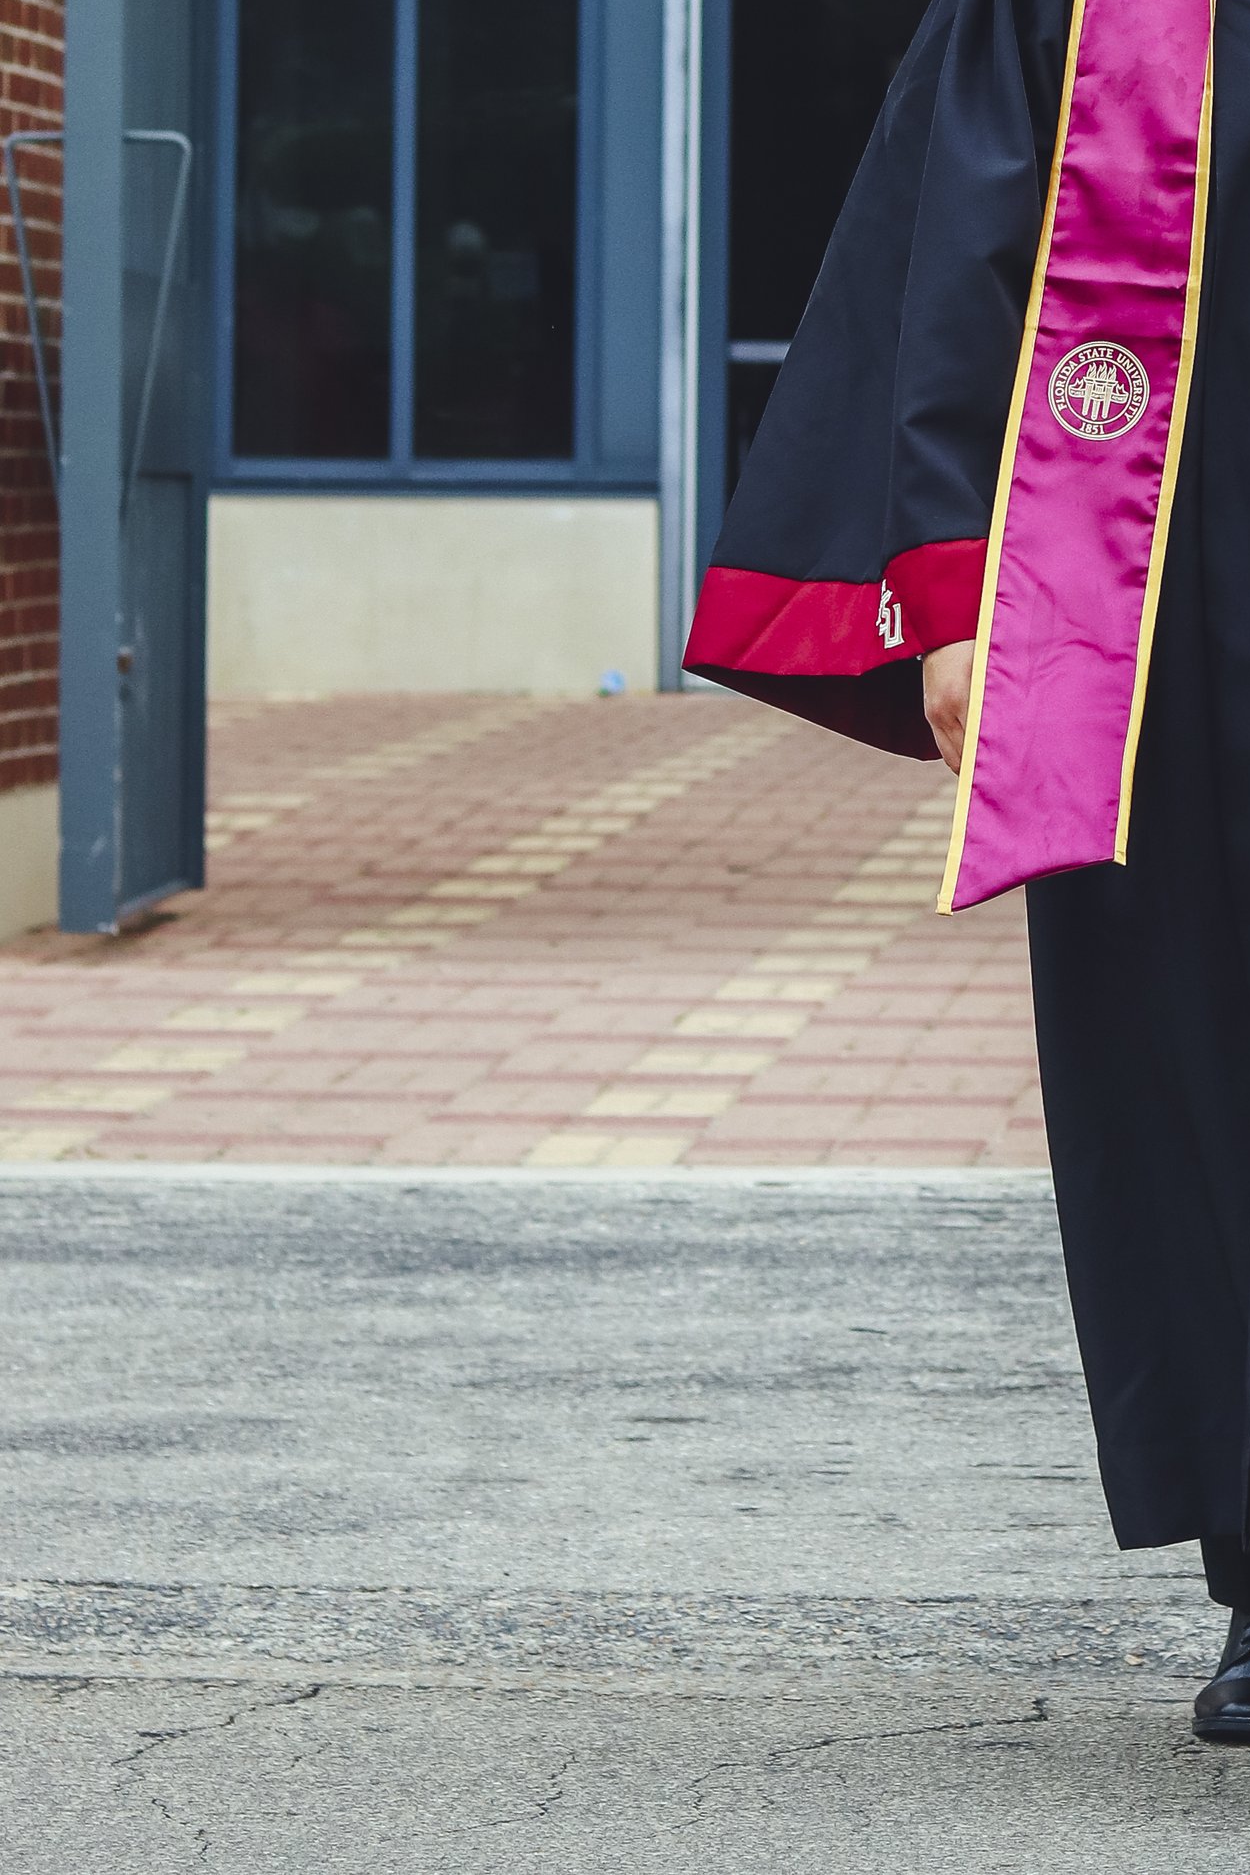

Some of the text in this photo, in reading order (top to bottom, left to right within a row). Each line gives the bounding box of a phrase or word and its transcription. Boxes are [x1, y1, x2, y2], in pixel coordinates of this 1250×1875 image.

[1054, 347, 1143, 422] FLORIDA STATE UNIVERSITY
[1079, 422, 1105, 435] 1851
